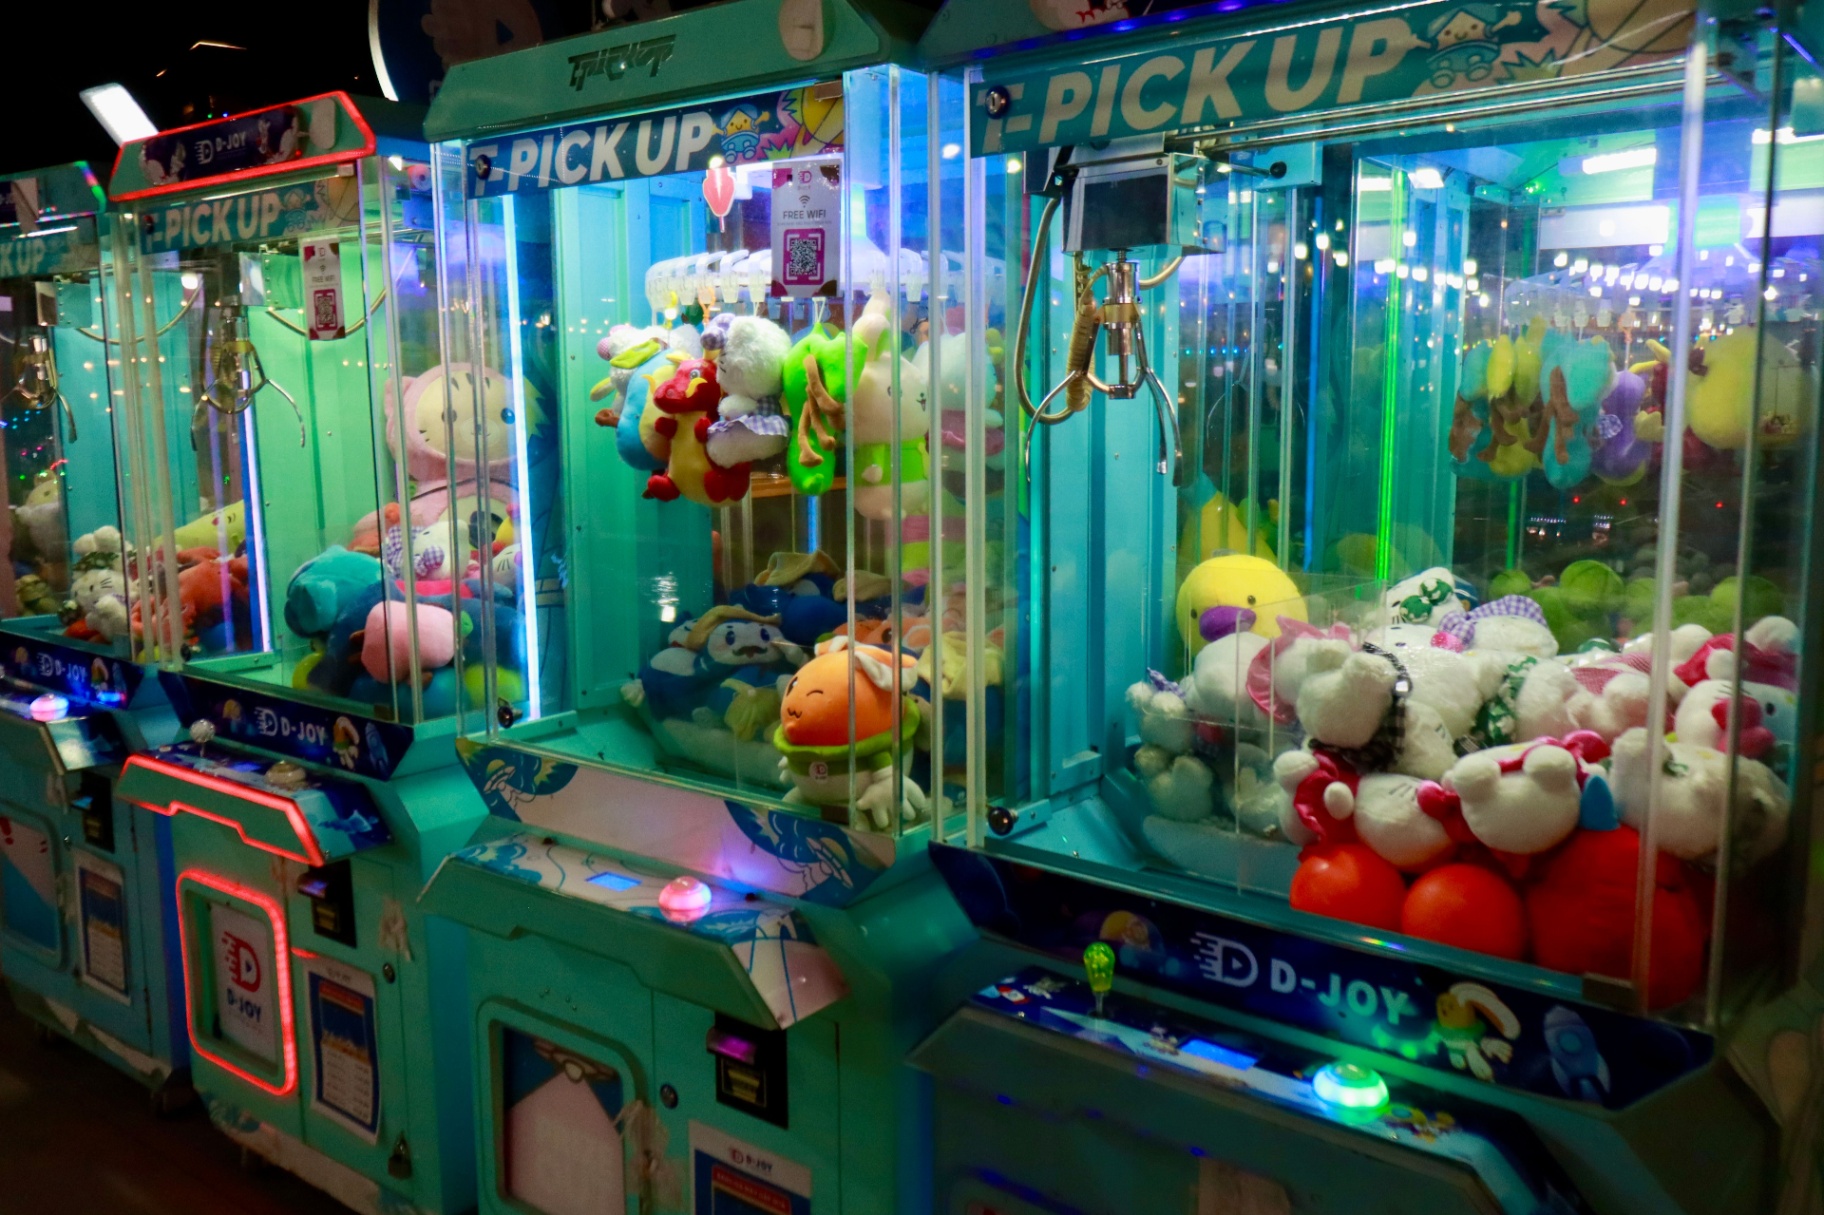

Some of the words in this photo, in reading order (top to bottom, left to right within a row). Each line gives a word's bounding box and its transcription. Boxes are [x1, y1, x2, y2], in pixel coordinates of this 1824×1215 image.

[1264, 17, 1411, 111] UP
[215, 131, 246, 152] D-JOY
[636, 111, 713, 176] UP
[237, 192, 279, 240] UP
[782, 210, 804, 220] FREE
[806, 209, 826, 219] WIFI
[15, 238, 46, 276] UP
[54, 659, 86, 682] D-JOY
[280, 716, 326, 746] D-JOY
[227, 987, 262, 1022] D-JOY
[1270, 957, 1409, 1026] D-JOY
